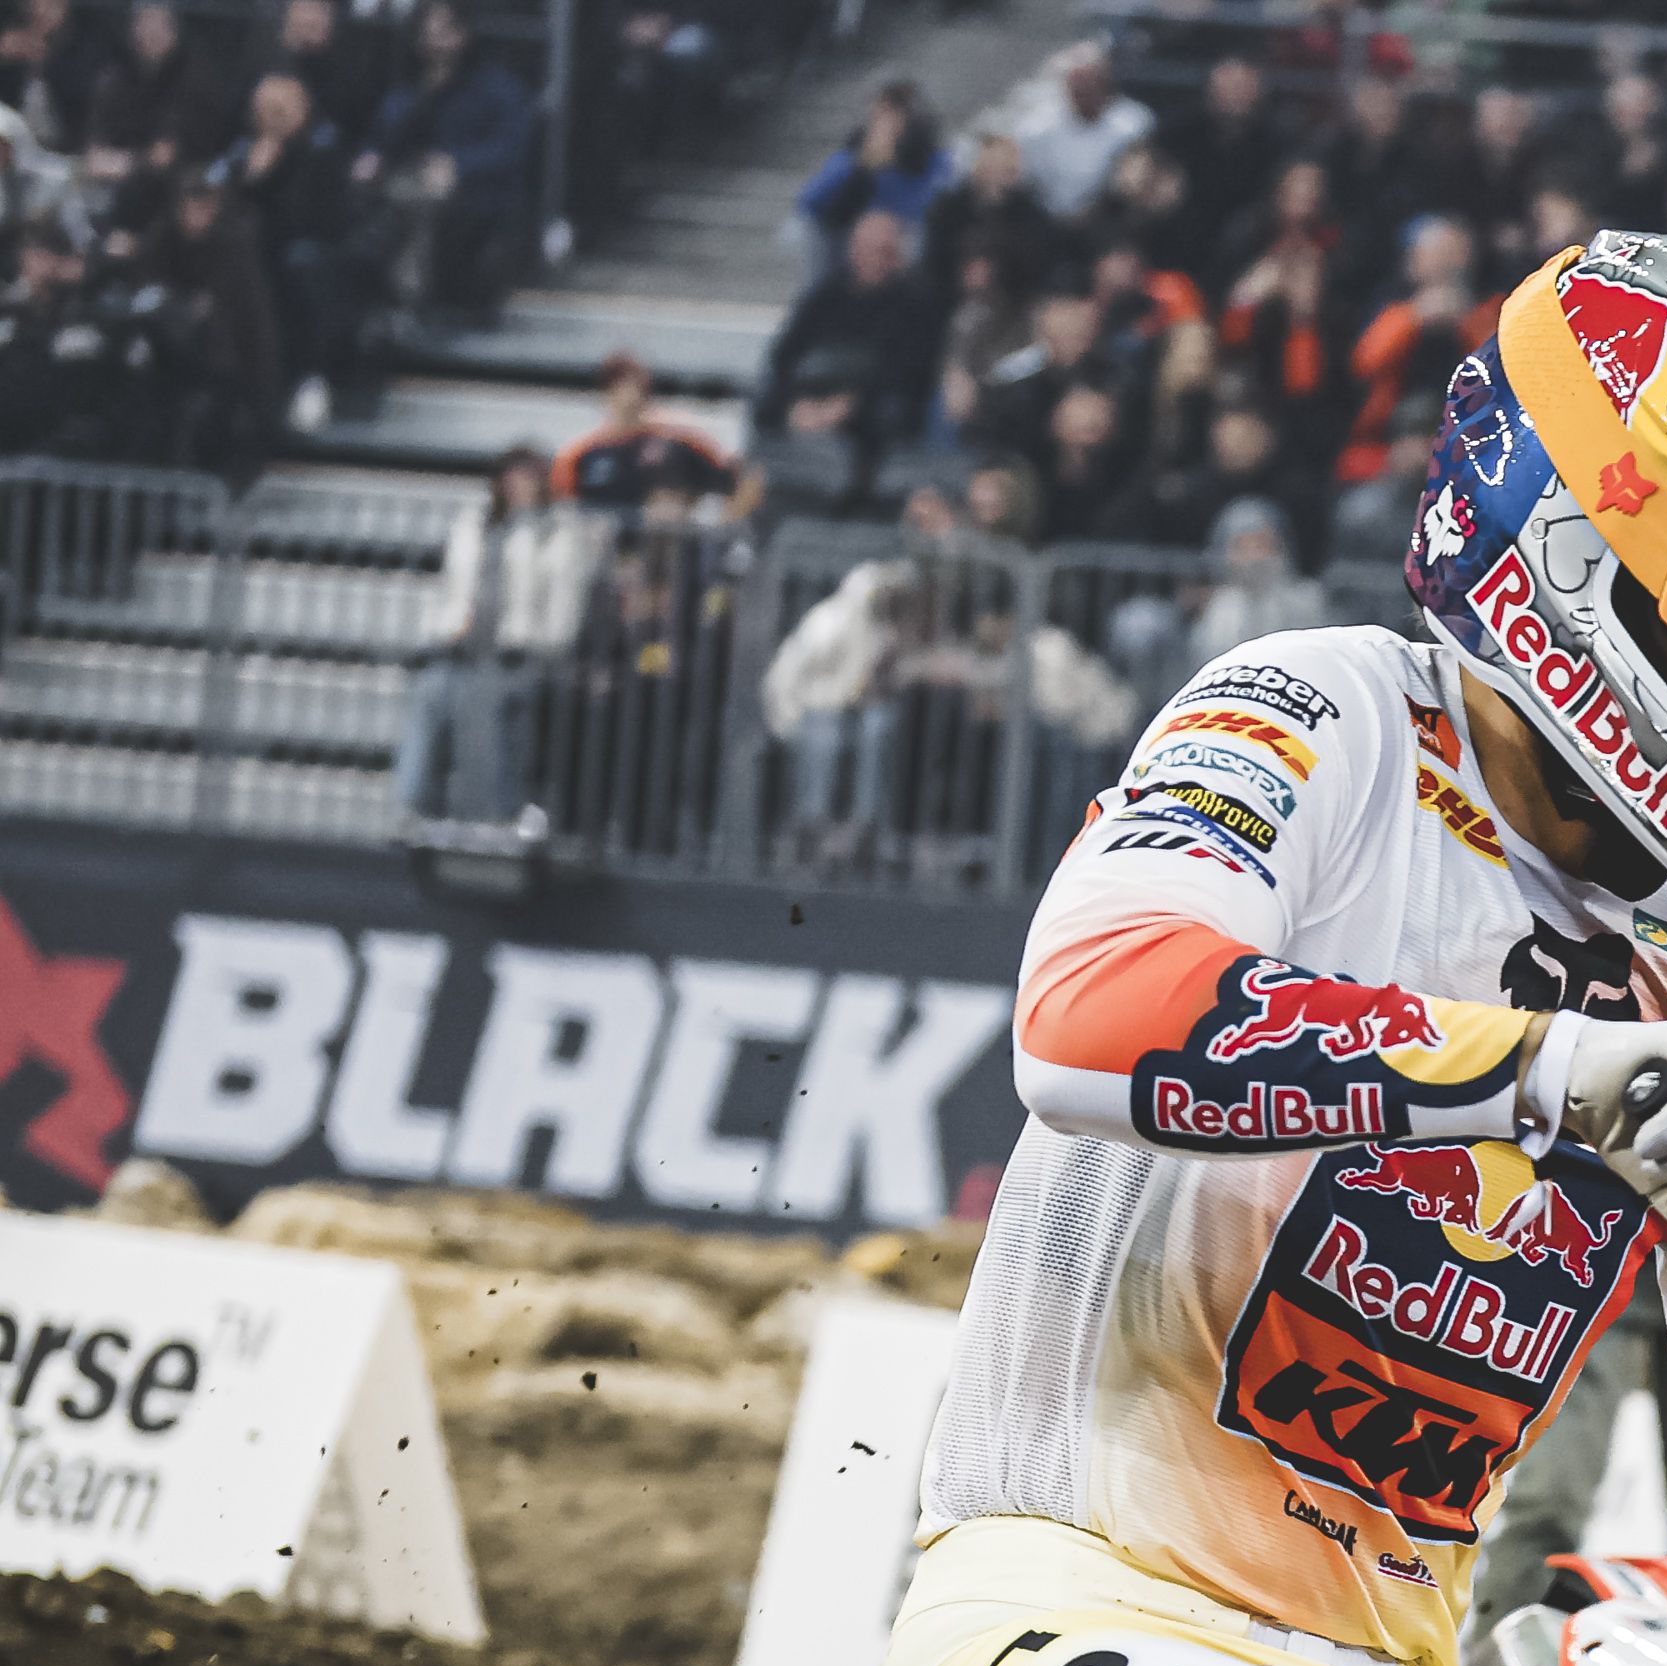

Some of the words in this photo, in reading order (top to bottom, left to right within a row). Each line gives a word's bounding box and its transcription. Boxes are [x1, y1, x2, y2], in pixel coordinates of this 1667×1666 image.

[1470, 550, 1597, 710] Red
[133, 912, 1018, 1227] BLACK
[1154, 1077, 1268, 1139] Red
[1274, 1082, 1386, 1138] Bull
[1304, 1215, 1460, 1346] Red
[1443, 1279, 1575, 1383] Bull
[1252, 1359, 1503, 1510] KTM
